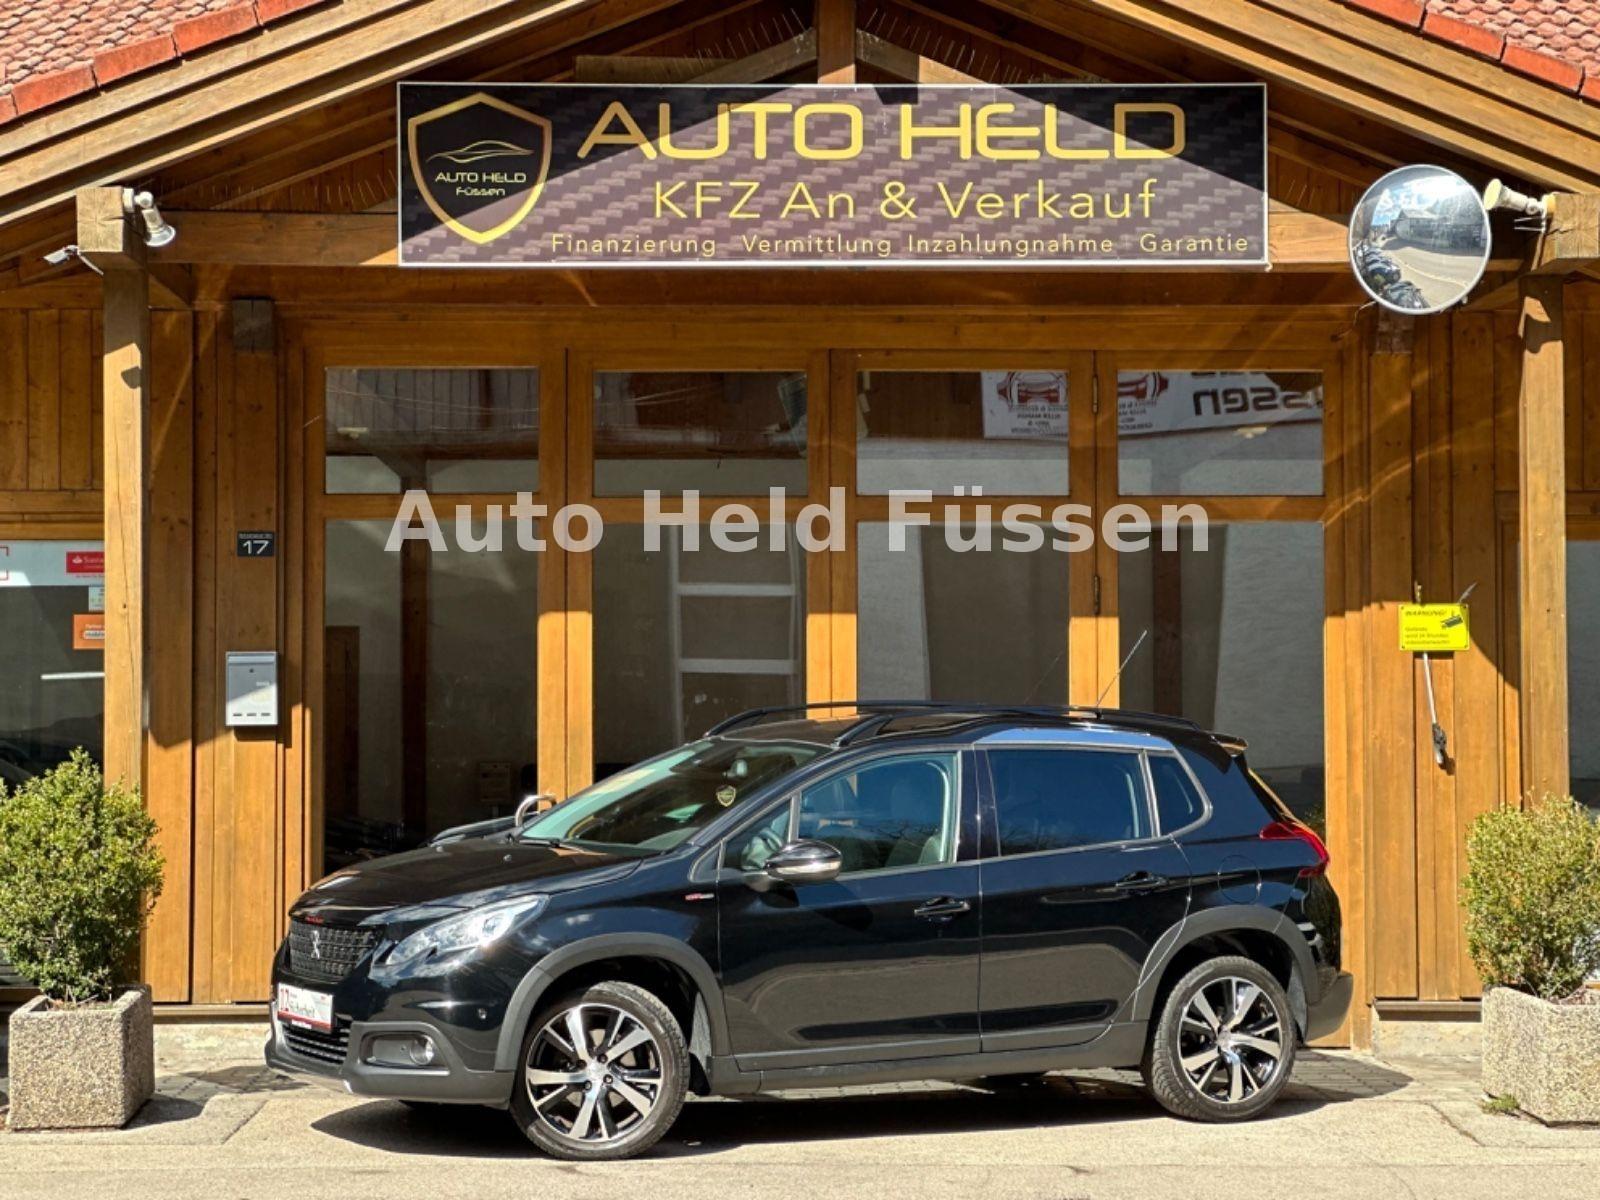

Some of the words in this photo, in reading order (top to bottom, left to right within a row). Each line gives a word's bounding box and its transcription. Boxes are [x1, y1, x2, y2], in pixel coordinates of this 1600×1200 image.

[577, 101, 864, 160] AUTO
[900, 102, 1186, 160] HELD
[435, 171, 479, 183] AUTO
[482, 171, 527, 183] HELD
[455, 186, 506, 196] Füssen
[655, 181, 761, 218] KFZ
[780, 181, 854, 218] An
[880, 181, 917, 219] &
[937, 178, 1158, 219] Verkauf
[551, 234, 716, 257] Finanzierung
[741, 234, 892, 257] Vermittlung
[908, 234, 1113, 257] Inzahlungnahme
[1140, 233, 1249, 253] Garantie
[242, 540, 269, 554] 17
